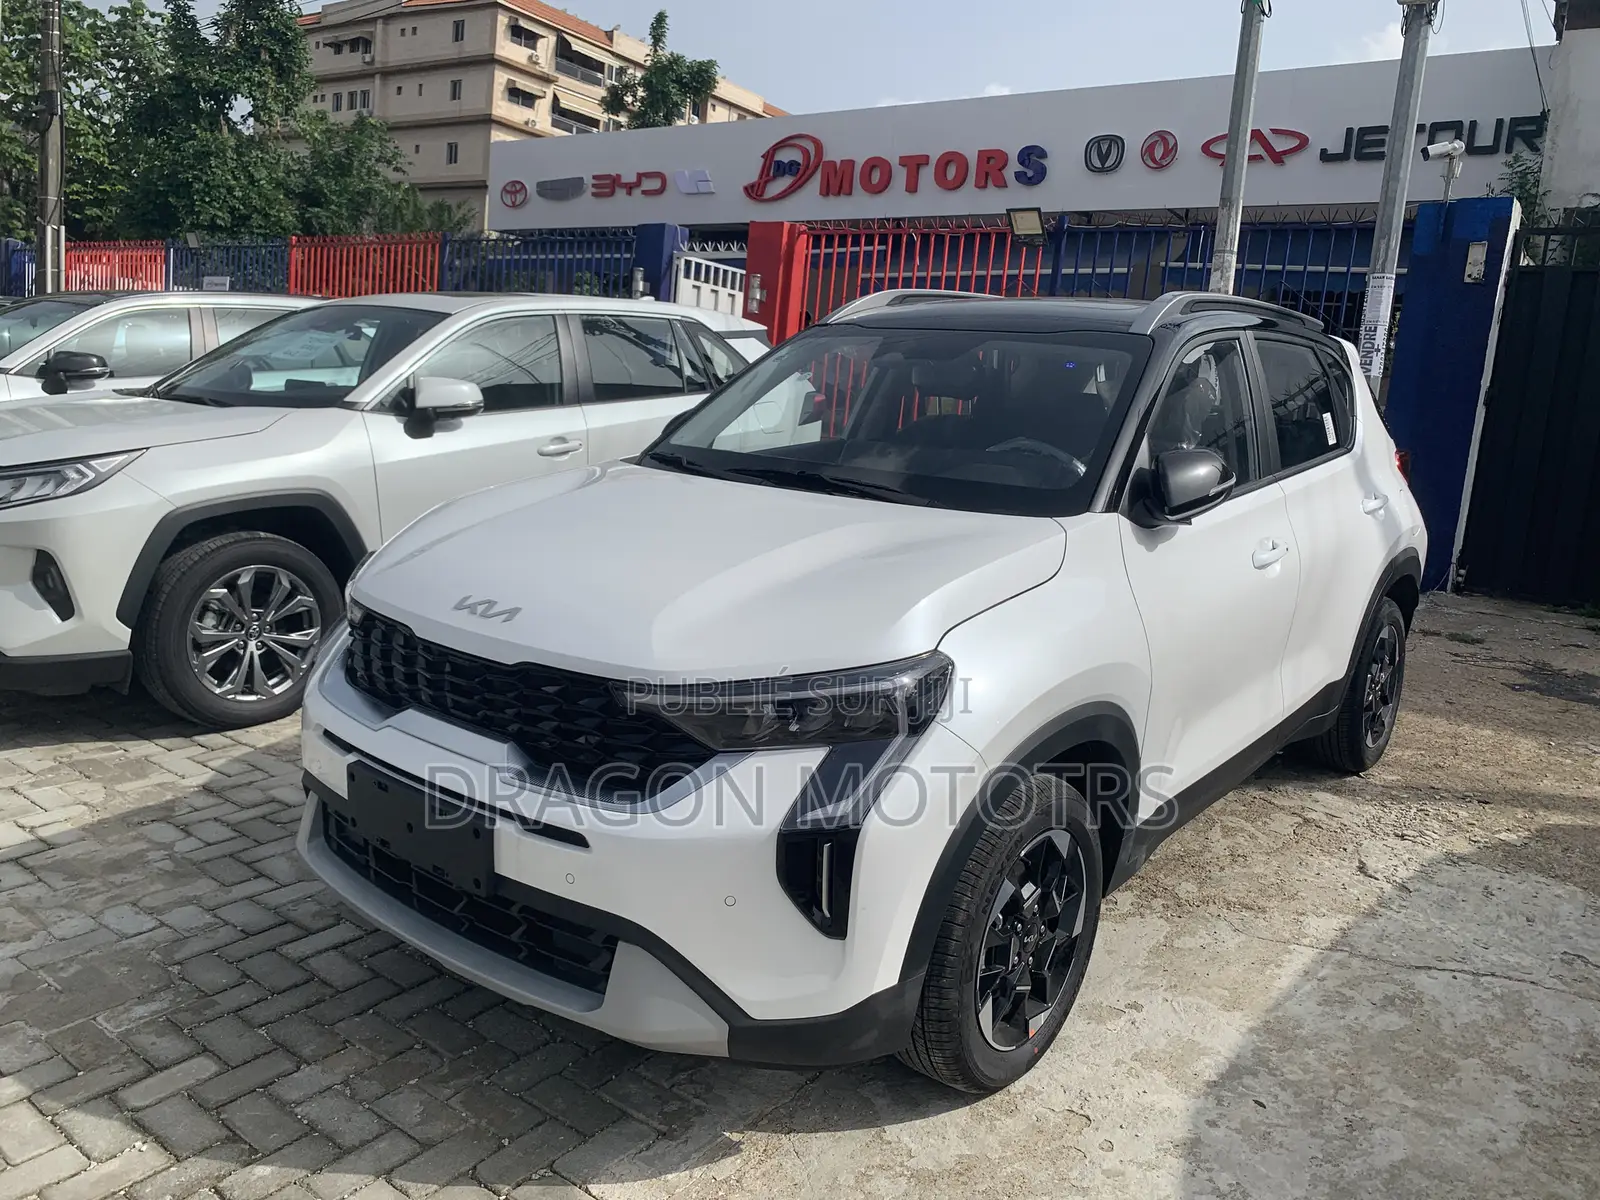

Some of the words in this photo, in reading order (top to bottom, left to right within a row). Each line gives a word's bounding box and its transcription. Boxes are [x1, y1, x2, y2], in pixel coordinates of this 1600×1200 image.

[1319, 115, 1545, 163] JEOUR
[591, 171, 667, 198] BYD
[819, 145, 1048, 197] MOTORS
